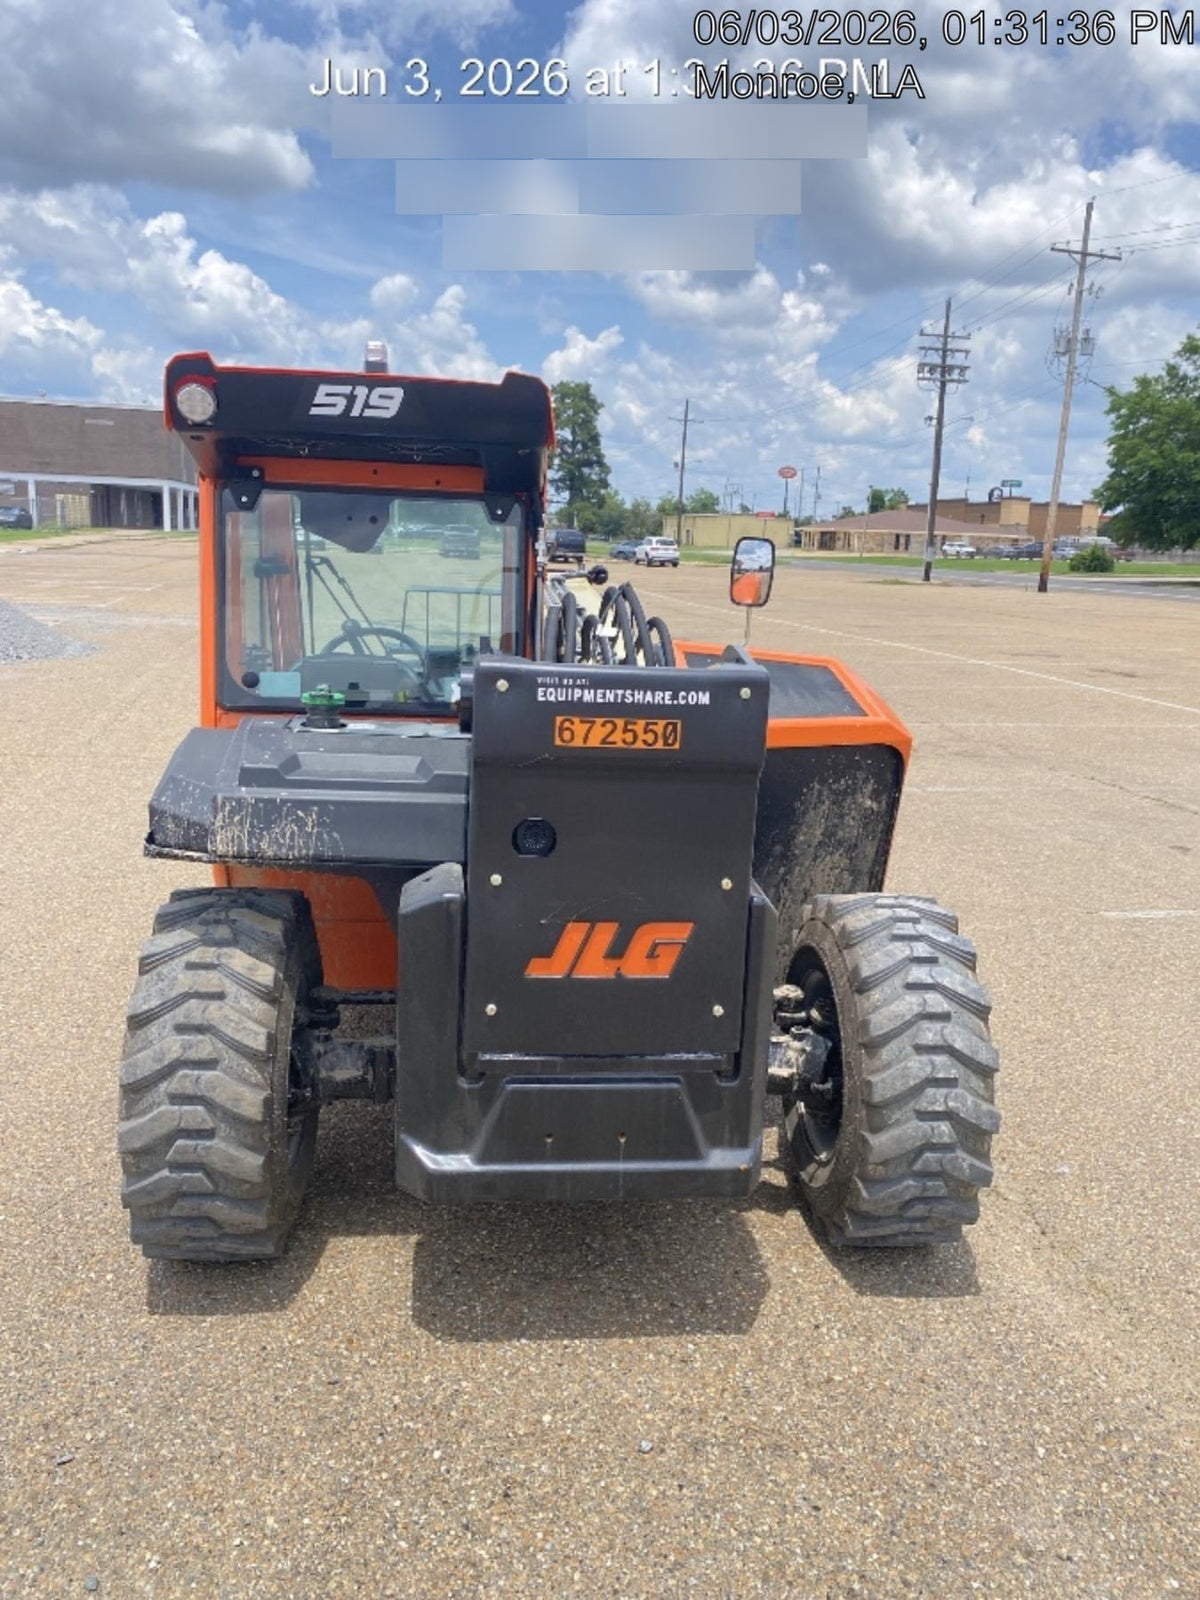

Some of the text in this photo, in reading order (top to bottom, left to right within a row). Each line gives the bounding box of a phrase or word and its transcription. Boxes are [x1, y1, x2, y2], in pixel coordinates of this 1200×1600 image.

[309, 384, 404, 419] 519
[537, 687, 711, 705] EQUIPMENTSHARE.COM
[557, 718, 678, 747] 672550
[524, 921, 695, 978] JLG
